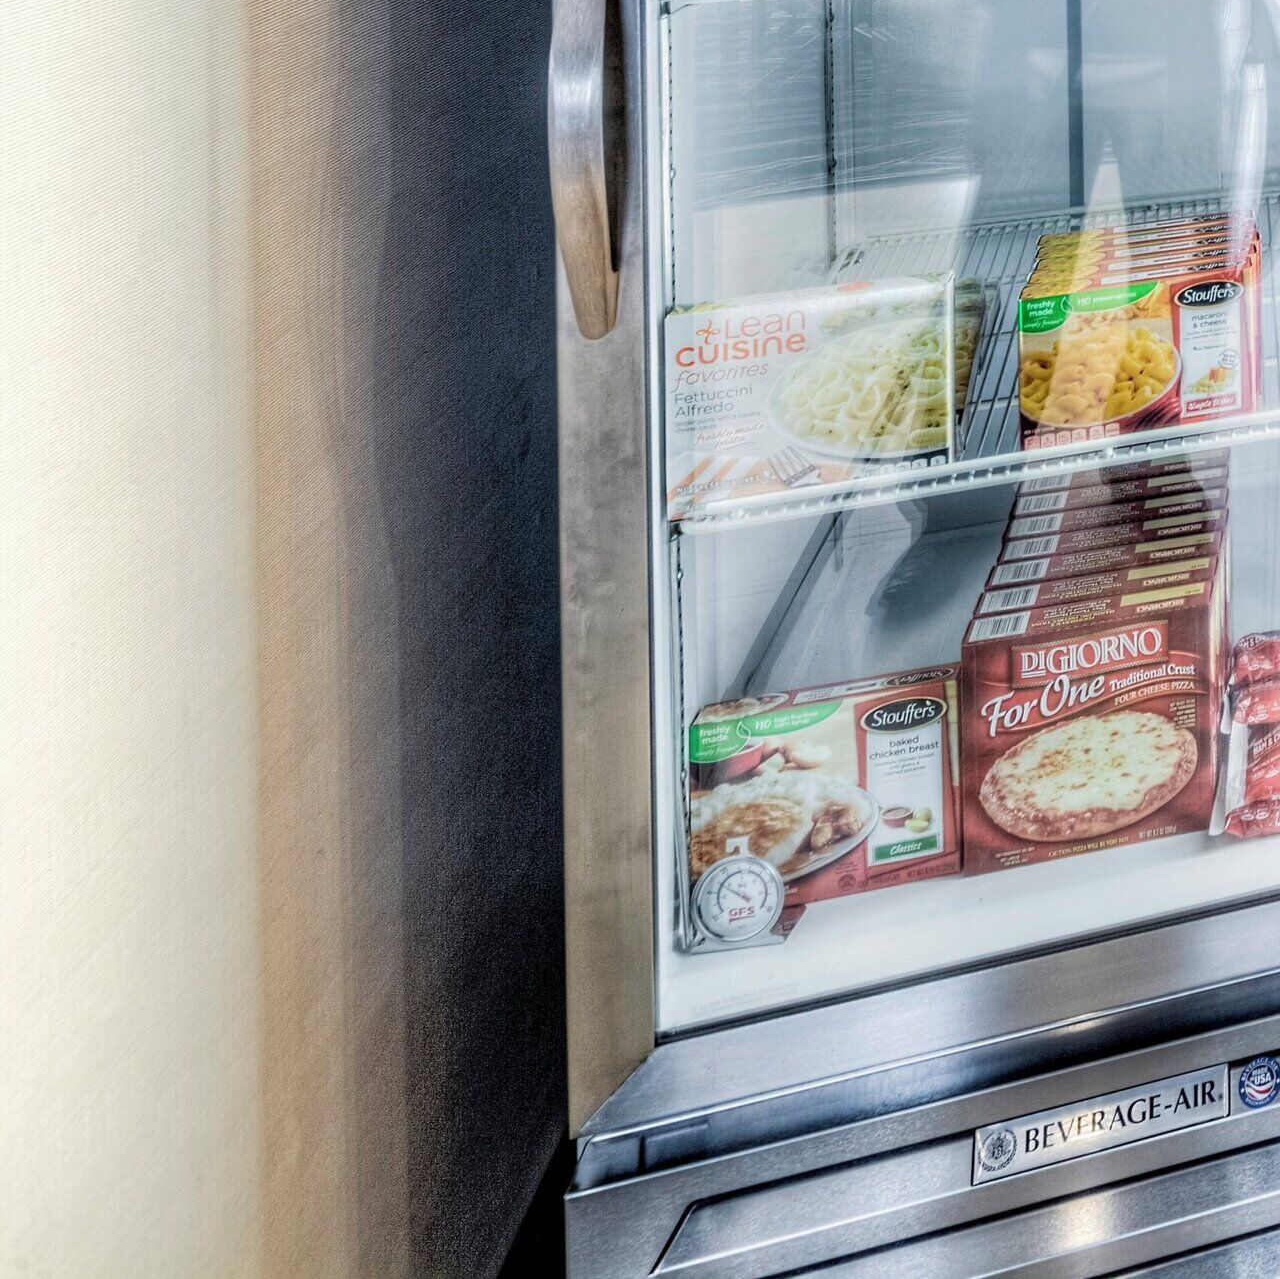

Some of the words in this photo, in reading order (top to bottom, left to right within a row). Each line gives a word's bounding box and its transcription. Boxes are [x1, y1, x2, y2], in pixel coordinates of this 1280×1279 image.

[1183, 283, 1236, 303] Stouffer's
[724, 311, 805, 339] Lean
[671, 362, 769, 392] favorites
[675, 385, 753, 405] Fettuccini
[675, 401, 734, 418] Alfredo
[1110, 666, 1167, 692] Traditional
[1167, 663, 1195, 678] Crust
[1115, 693, 1137, 706] FOUR
[1138, 685, 1170, 700] CHEESE
[1171, 681, 1195, 693] PIZZA
[871, 700, 935, 727] Stouffer's
[981, 691, 1037, 737] For
[1040, 675, 1105, 716] One
[869, 748, 906, 760] chicken
[909, 742, 939, 753] breast
[890, 736, 919, 747] baked
[890, 842, 922, 855] Classics
[729, 907, 755, 917] GFS
[1024, 1081, 1216, 1153] BEVERAGE-AIR
